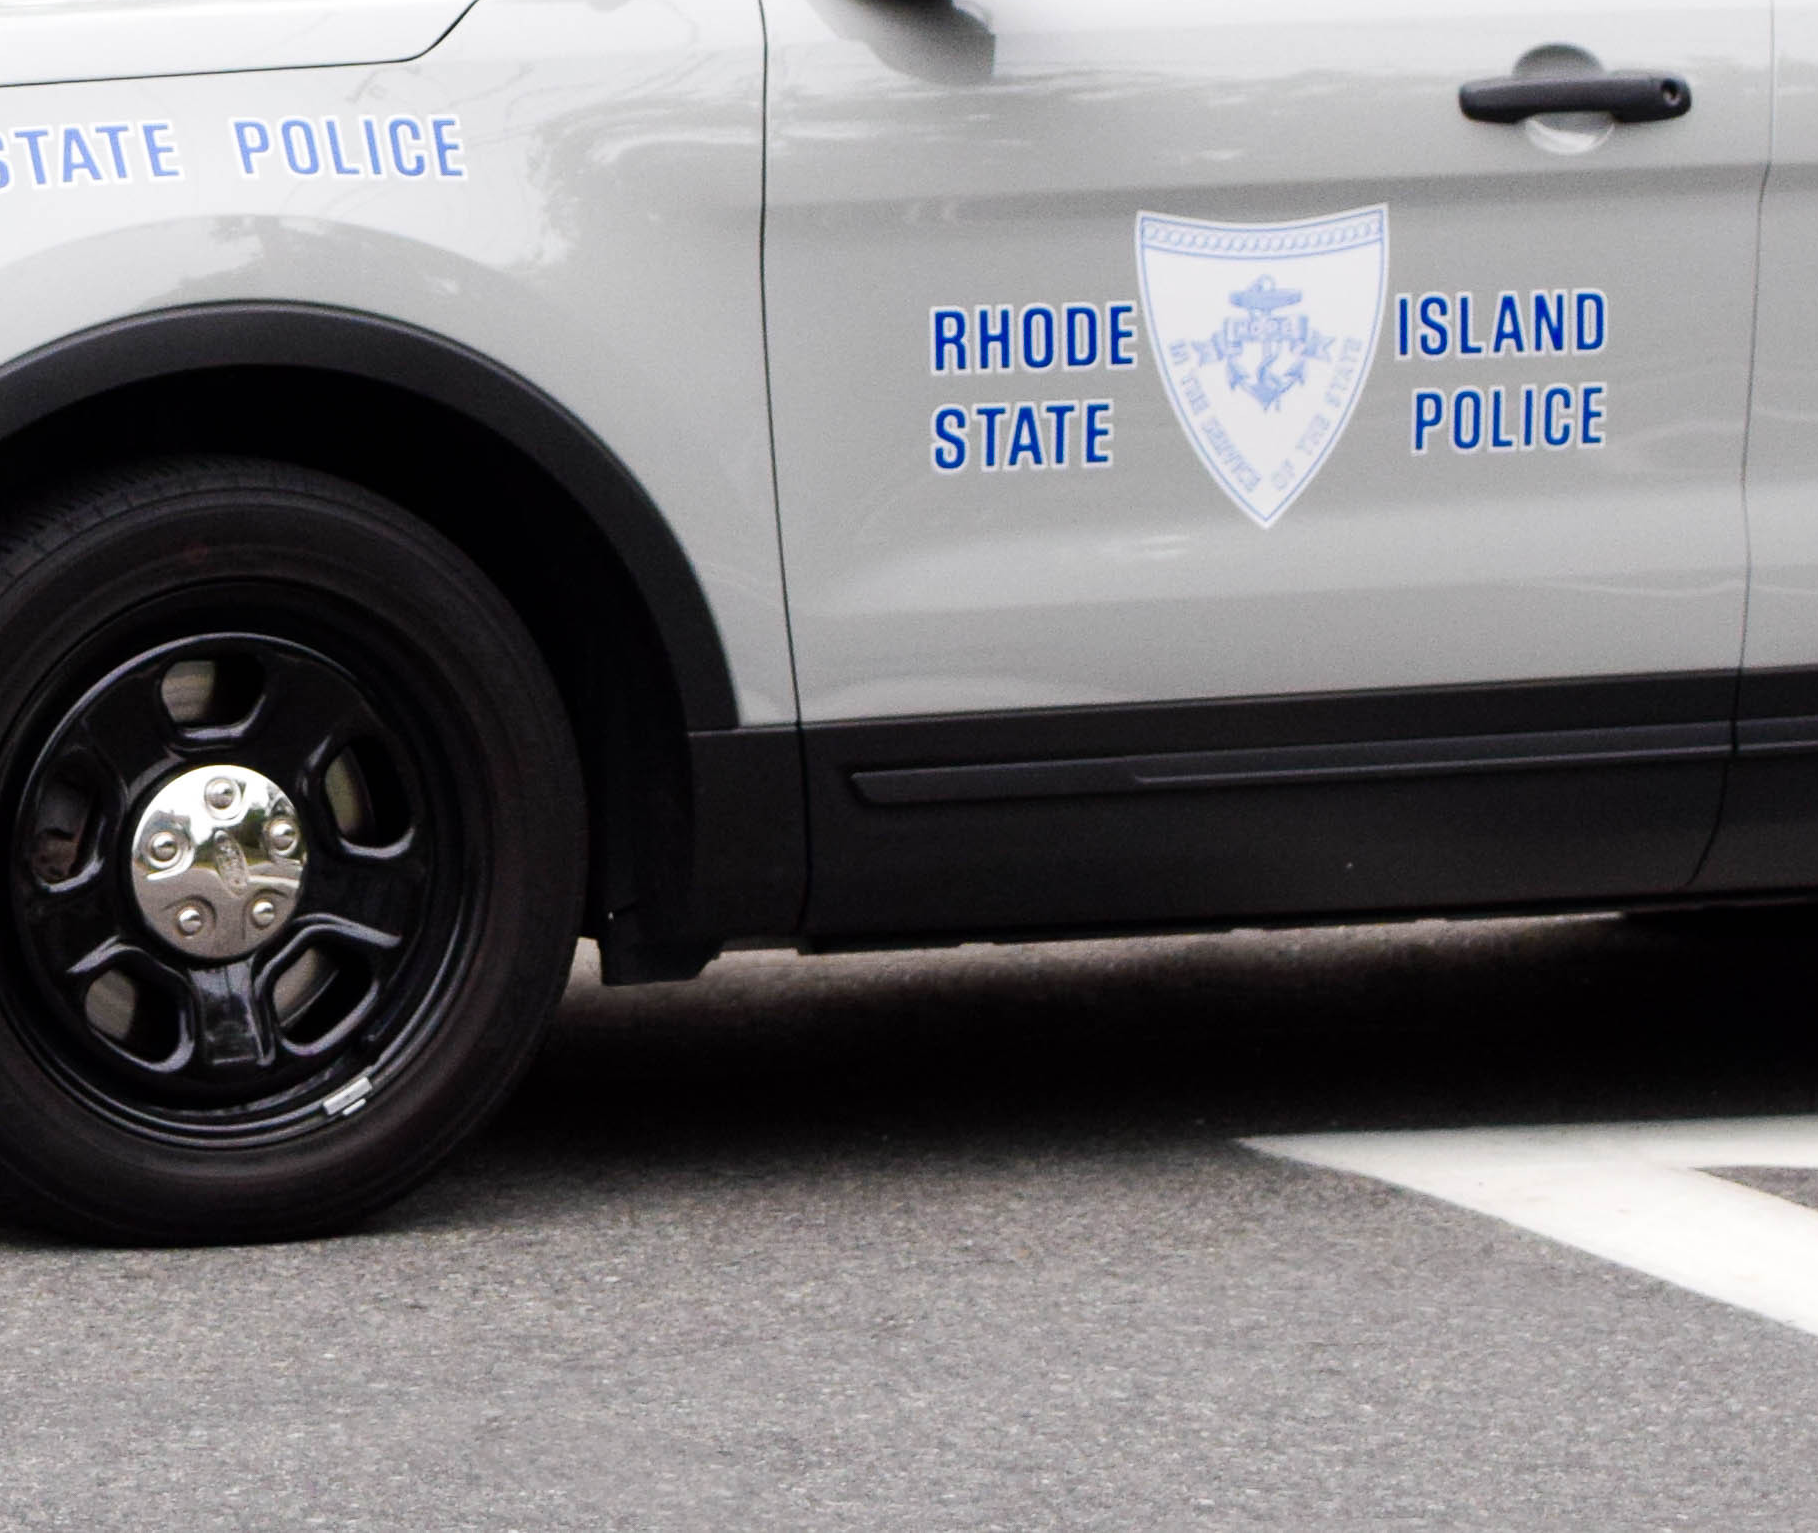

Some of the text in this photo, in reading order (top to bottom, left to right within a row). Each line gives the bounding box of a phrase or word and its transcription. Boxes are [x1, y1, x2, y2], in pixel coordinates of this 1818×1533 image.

[233, 118, 465, 178] POLICE
[934, 291, 1606, 372] RHODE ISLAND
[934, 385, 1604, 470] STATE POLICE
